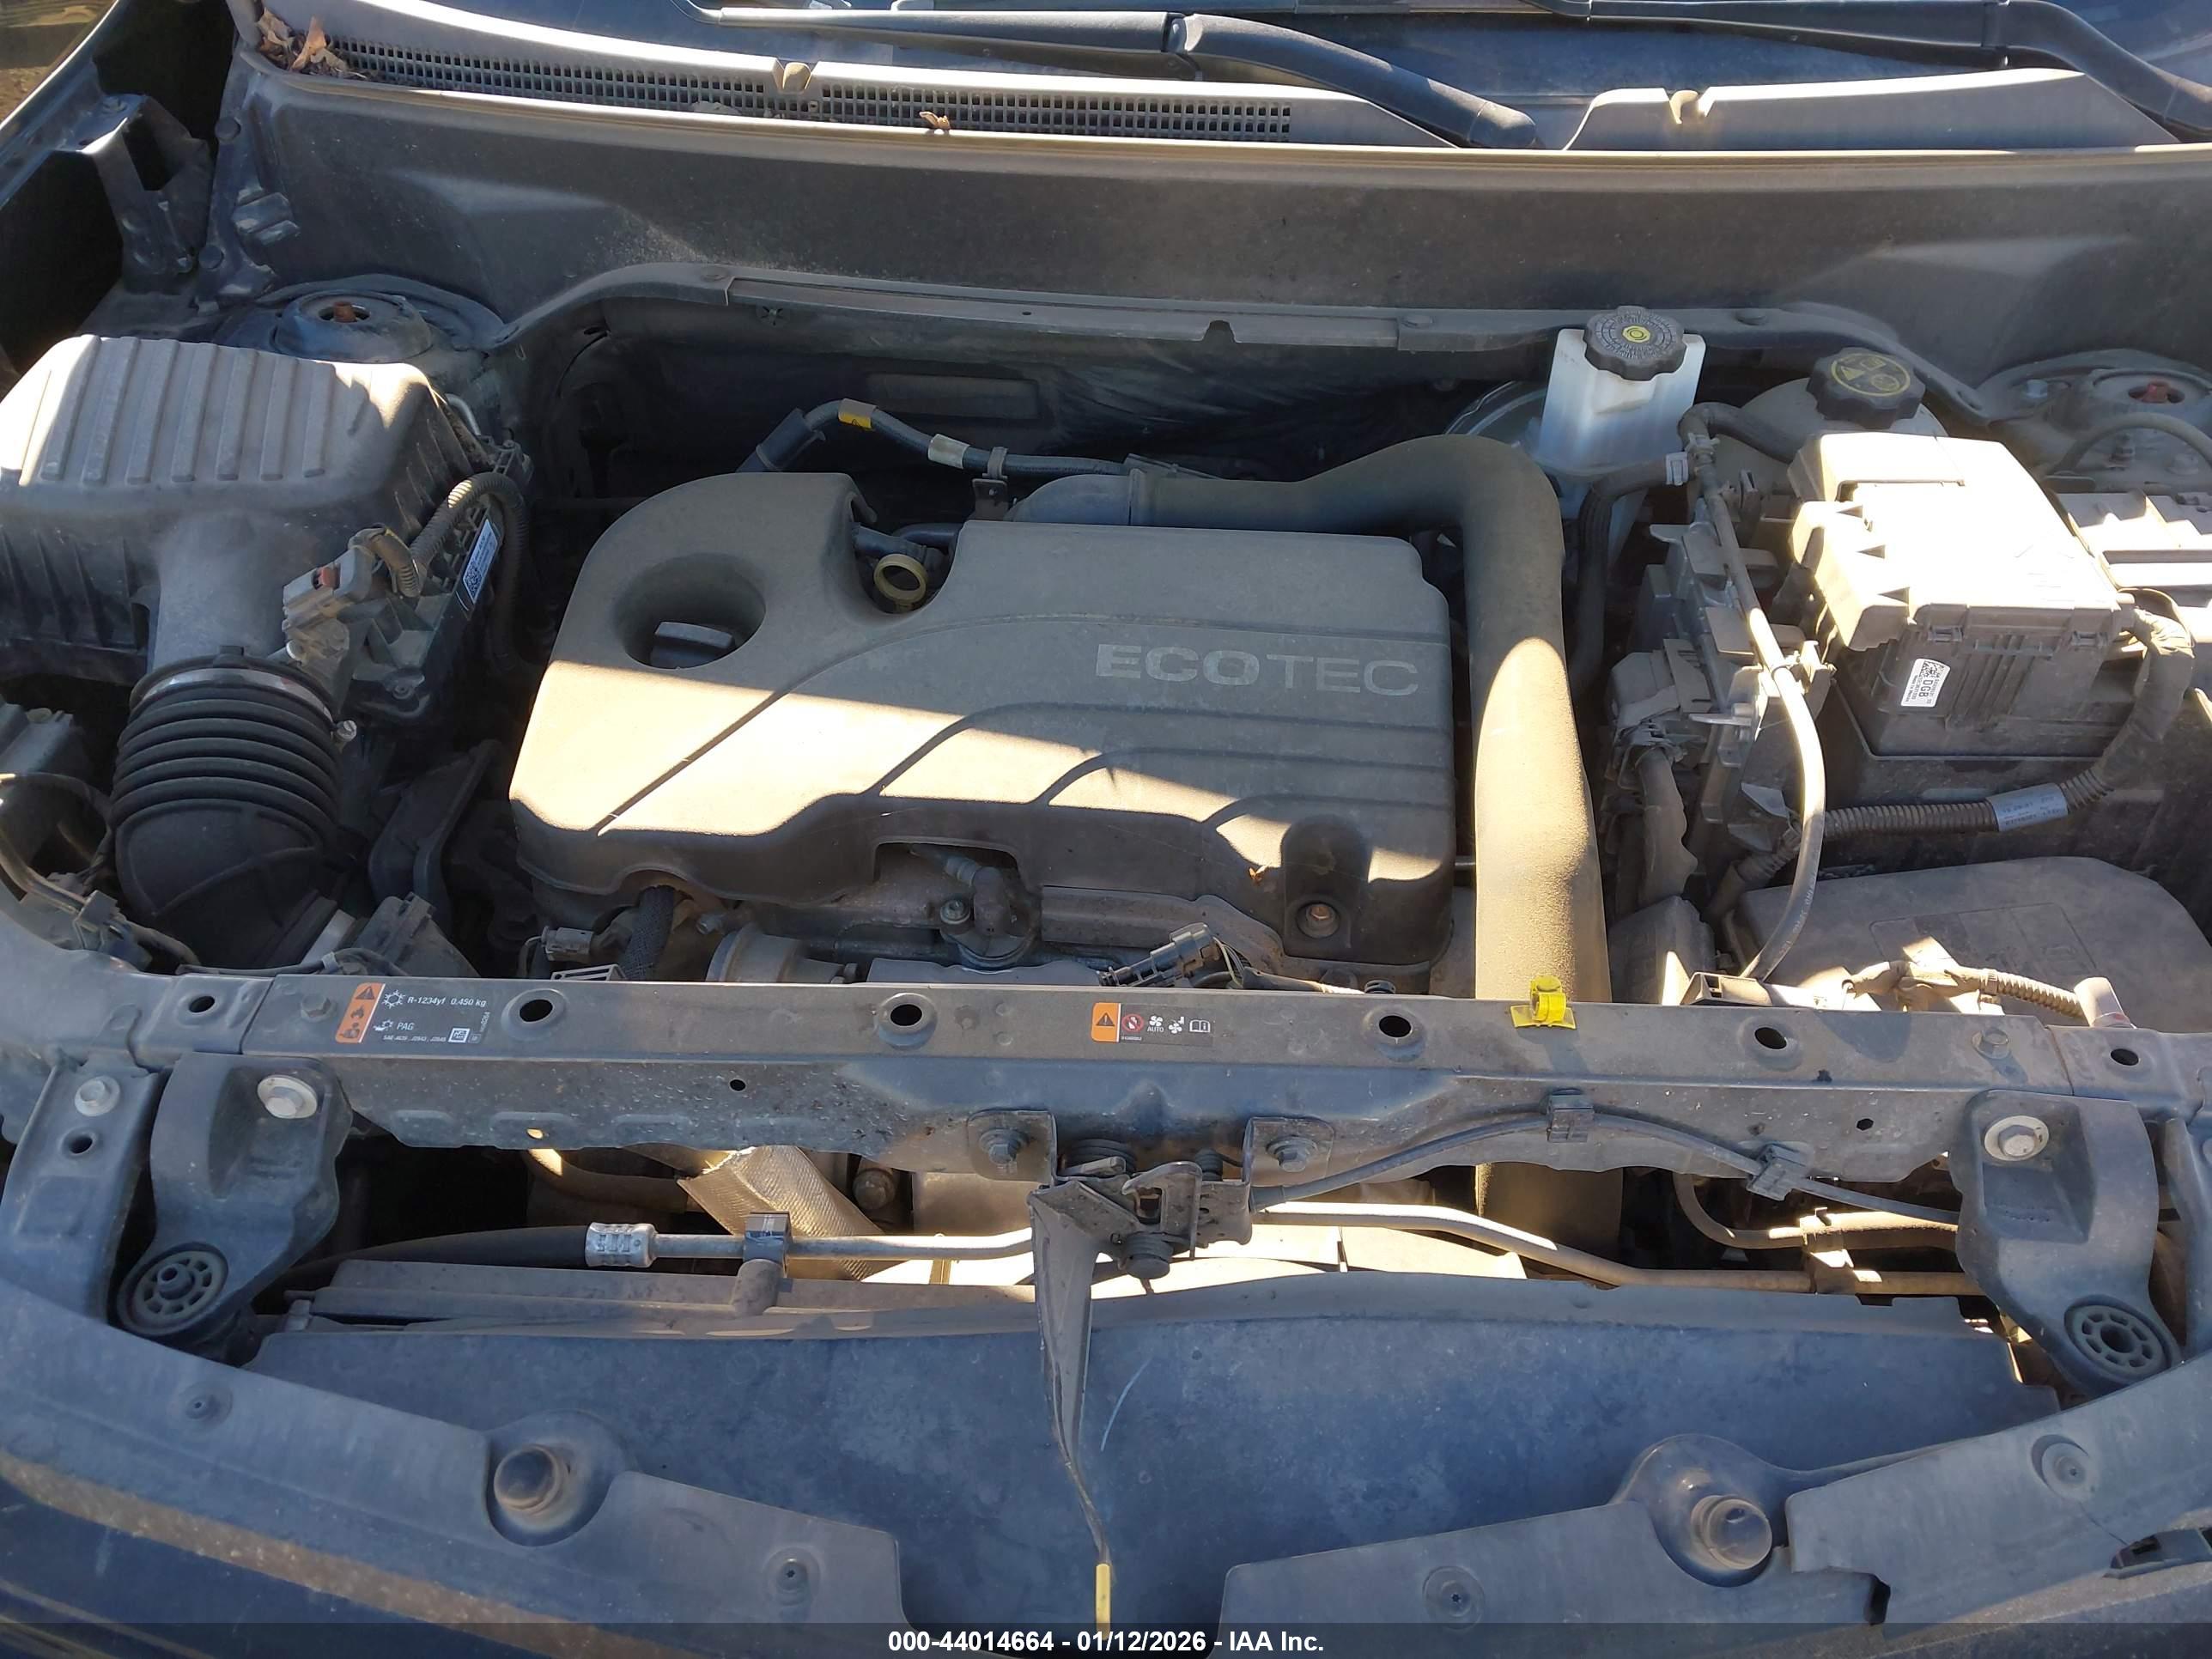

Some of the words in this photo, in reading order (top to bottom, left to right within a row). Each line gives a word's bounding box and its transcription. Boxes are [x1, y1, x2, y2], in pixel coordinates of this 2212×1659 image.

[1096, 643, 1419, 696] ECOTEC
[407, 996, 447, 1006] R-1234yf
[450, 998, 474, 1006] 0.450
[475, 999, 487, 1008] kg
[397, 1022, 415, 1030] PAG
